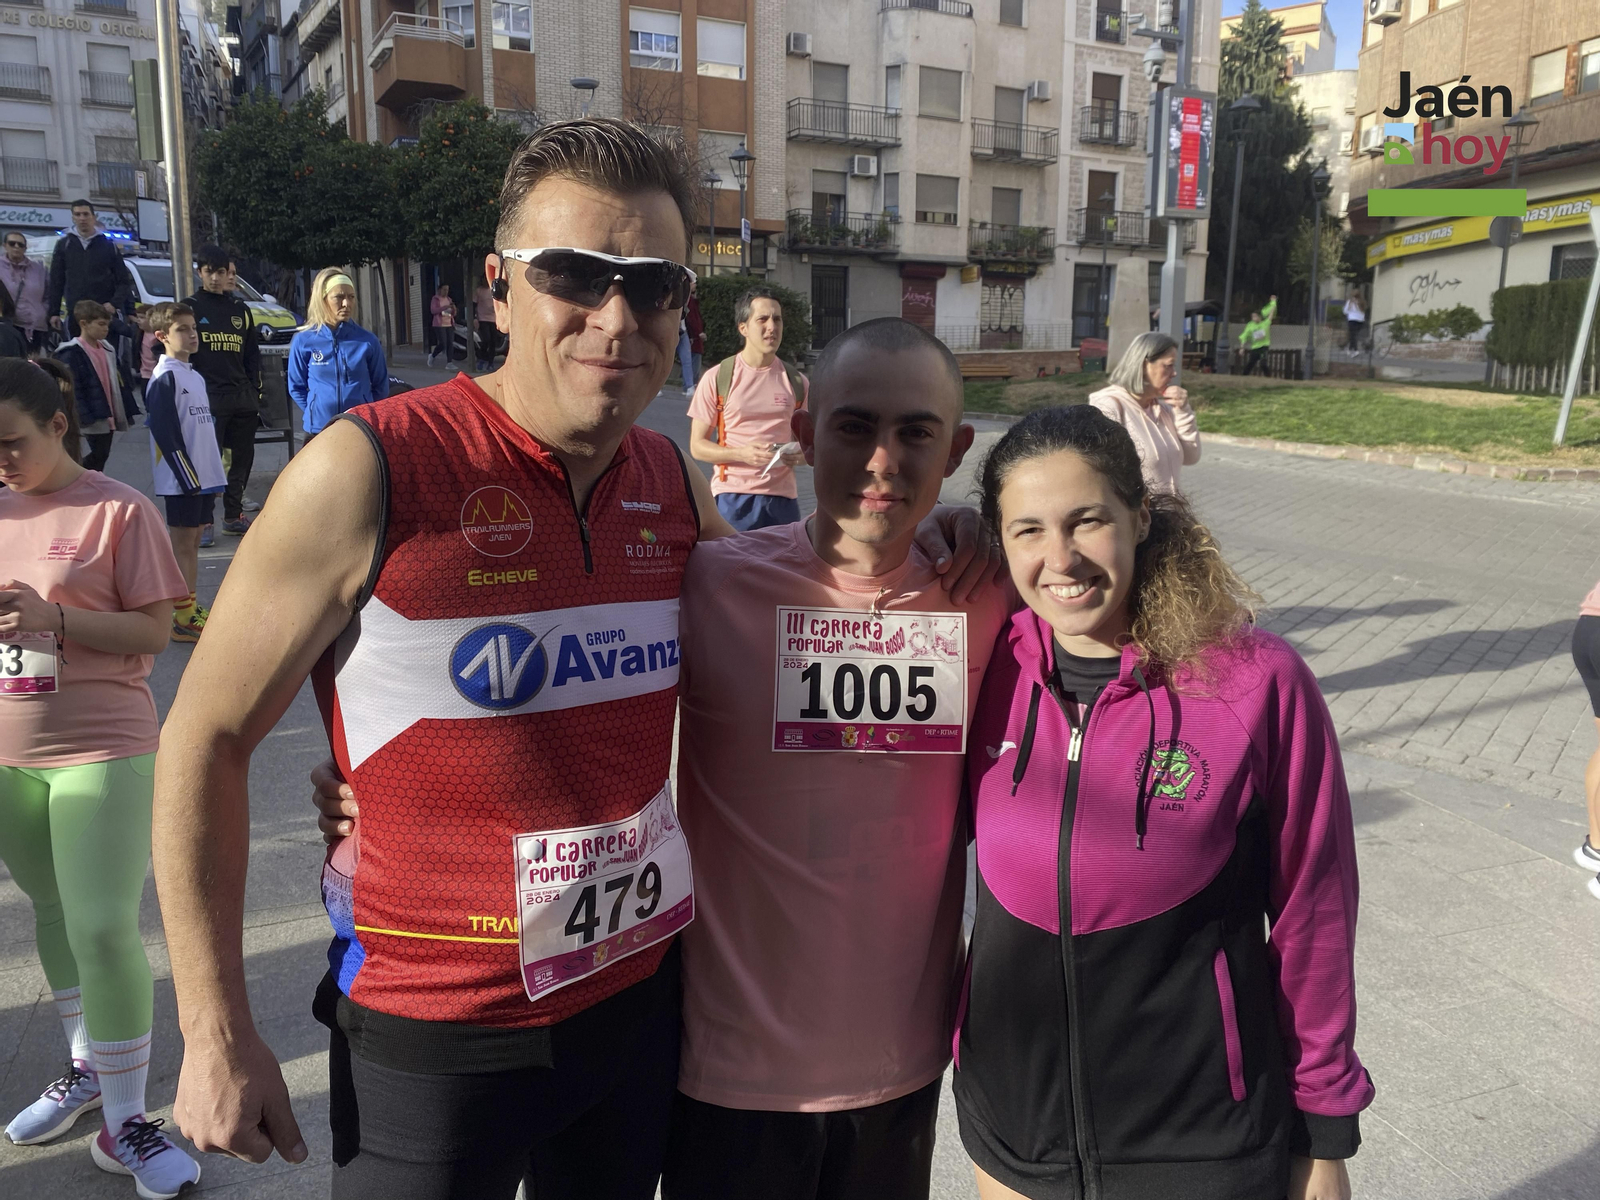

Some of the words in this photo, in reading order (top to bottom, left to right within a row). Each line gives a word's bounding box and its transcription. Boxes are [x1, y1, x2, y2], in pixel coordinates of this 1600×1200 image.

[0, 8, 20, 26] RE
[28, 12, 92, 32] COLEGIO
[100, 21, 156, 41] OFICIAL
[1403, 225, 1453, 245] masymas
[201, 331, 243, 345] Emirates
[210, 342, 221, 352] FLY
[222, 343, 241, 353] BETTER
[465, 523, 531, 534] TRAILRUNNERS
[488, 533, 512, 542] JAEN
[625, 544, 671, 558] RODMA
[787, 612, 805, 635] III
[586, 628, 626, 647] GRUPO
[552, 634, 680, 688] Avanz
[783, 661, 809, 669] 2024
[800, 662, 937, 722] 1005
[1160, 802, 1184, 812] JAÉN
[526, 894, 561, 905] 2024
[564, 861, 662, 945] 479
